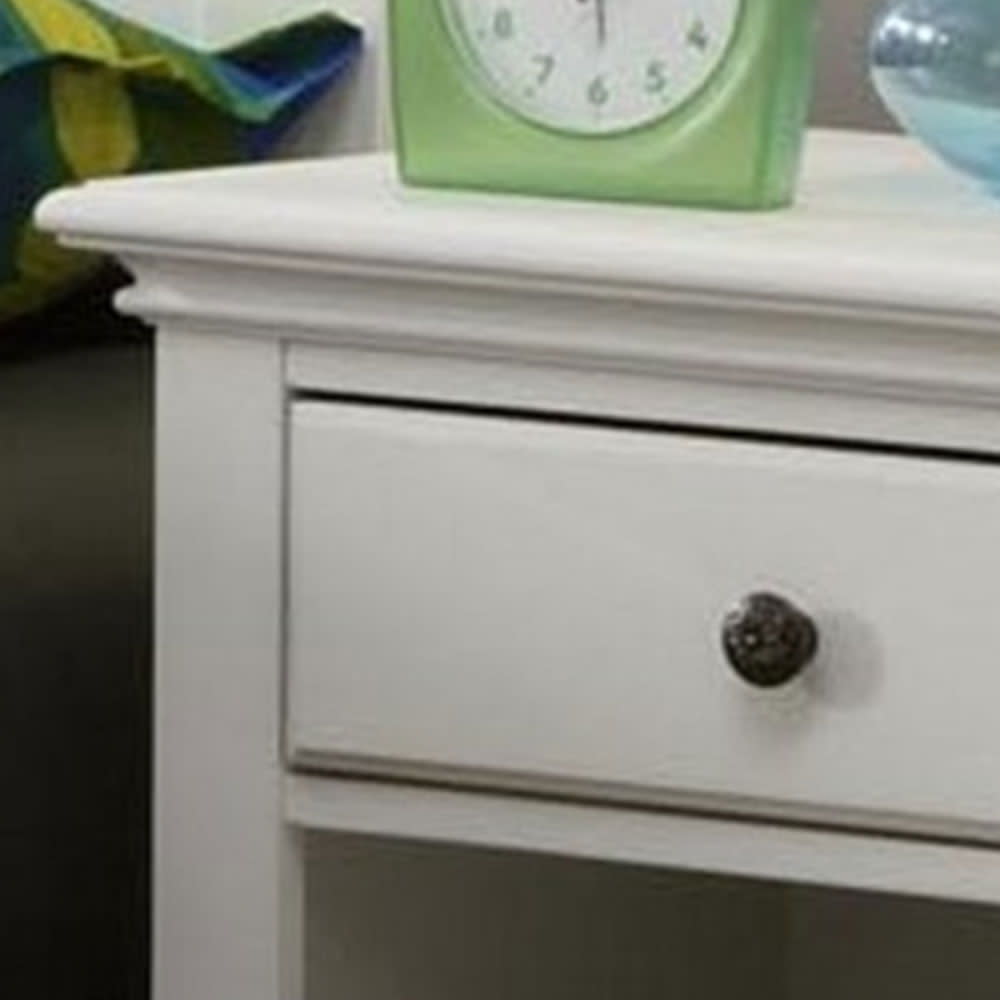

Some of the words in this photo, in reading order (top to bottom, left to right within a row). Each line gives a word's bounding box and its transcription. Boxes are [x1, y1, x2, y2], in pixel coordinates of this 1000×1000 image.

[686, 19, 709, 50] 4
[530, 53, 556, 84] 7
[644, 60, 667, 93] 5
[587, 73, 609, 106] 6
